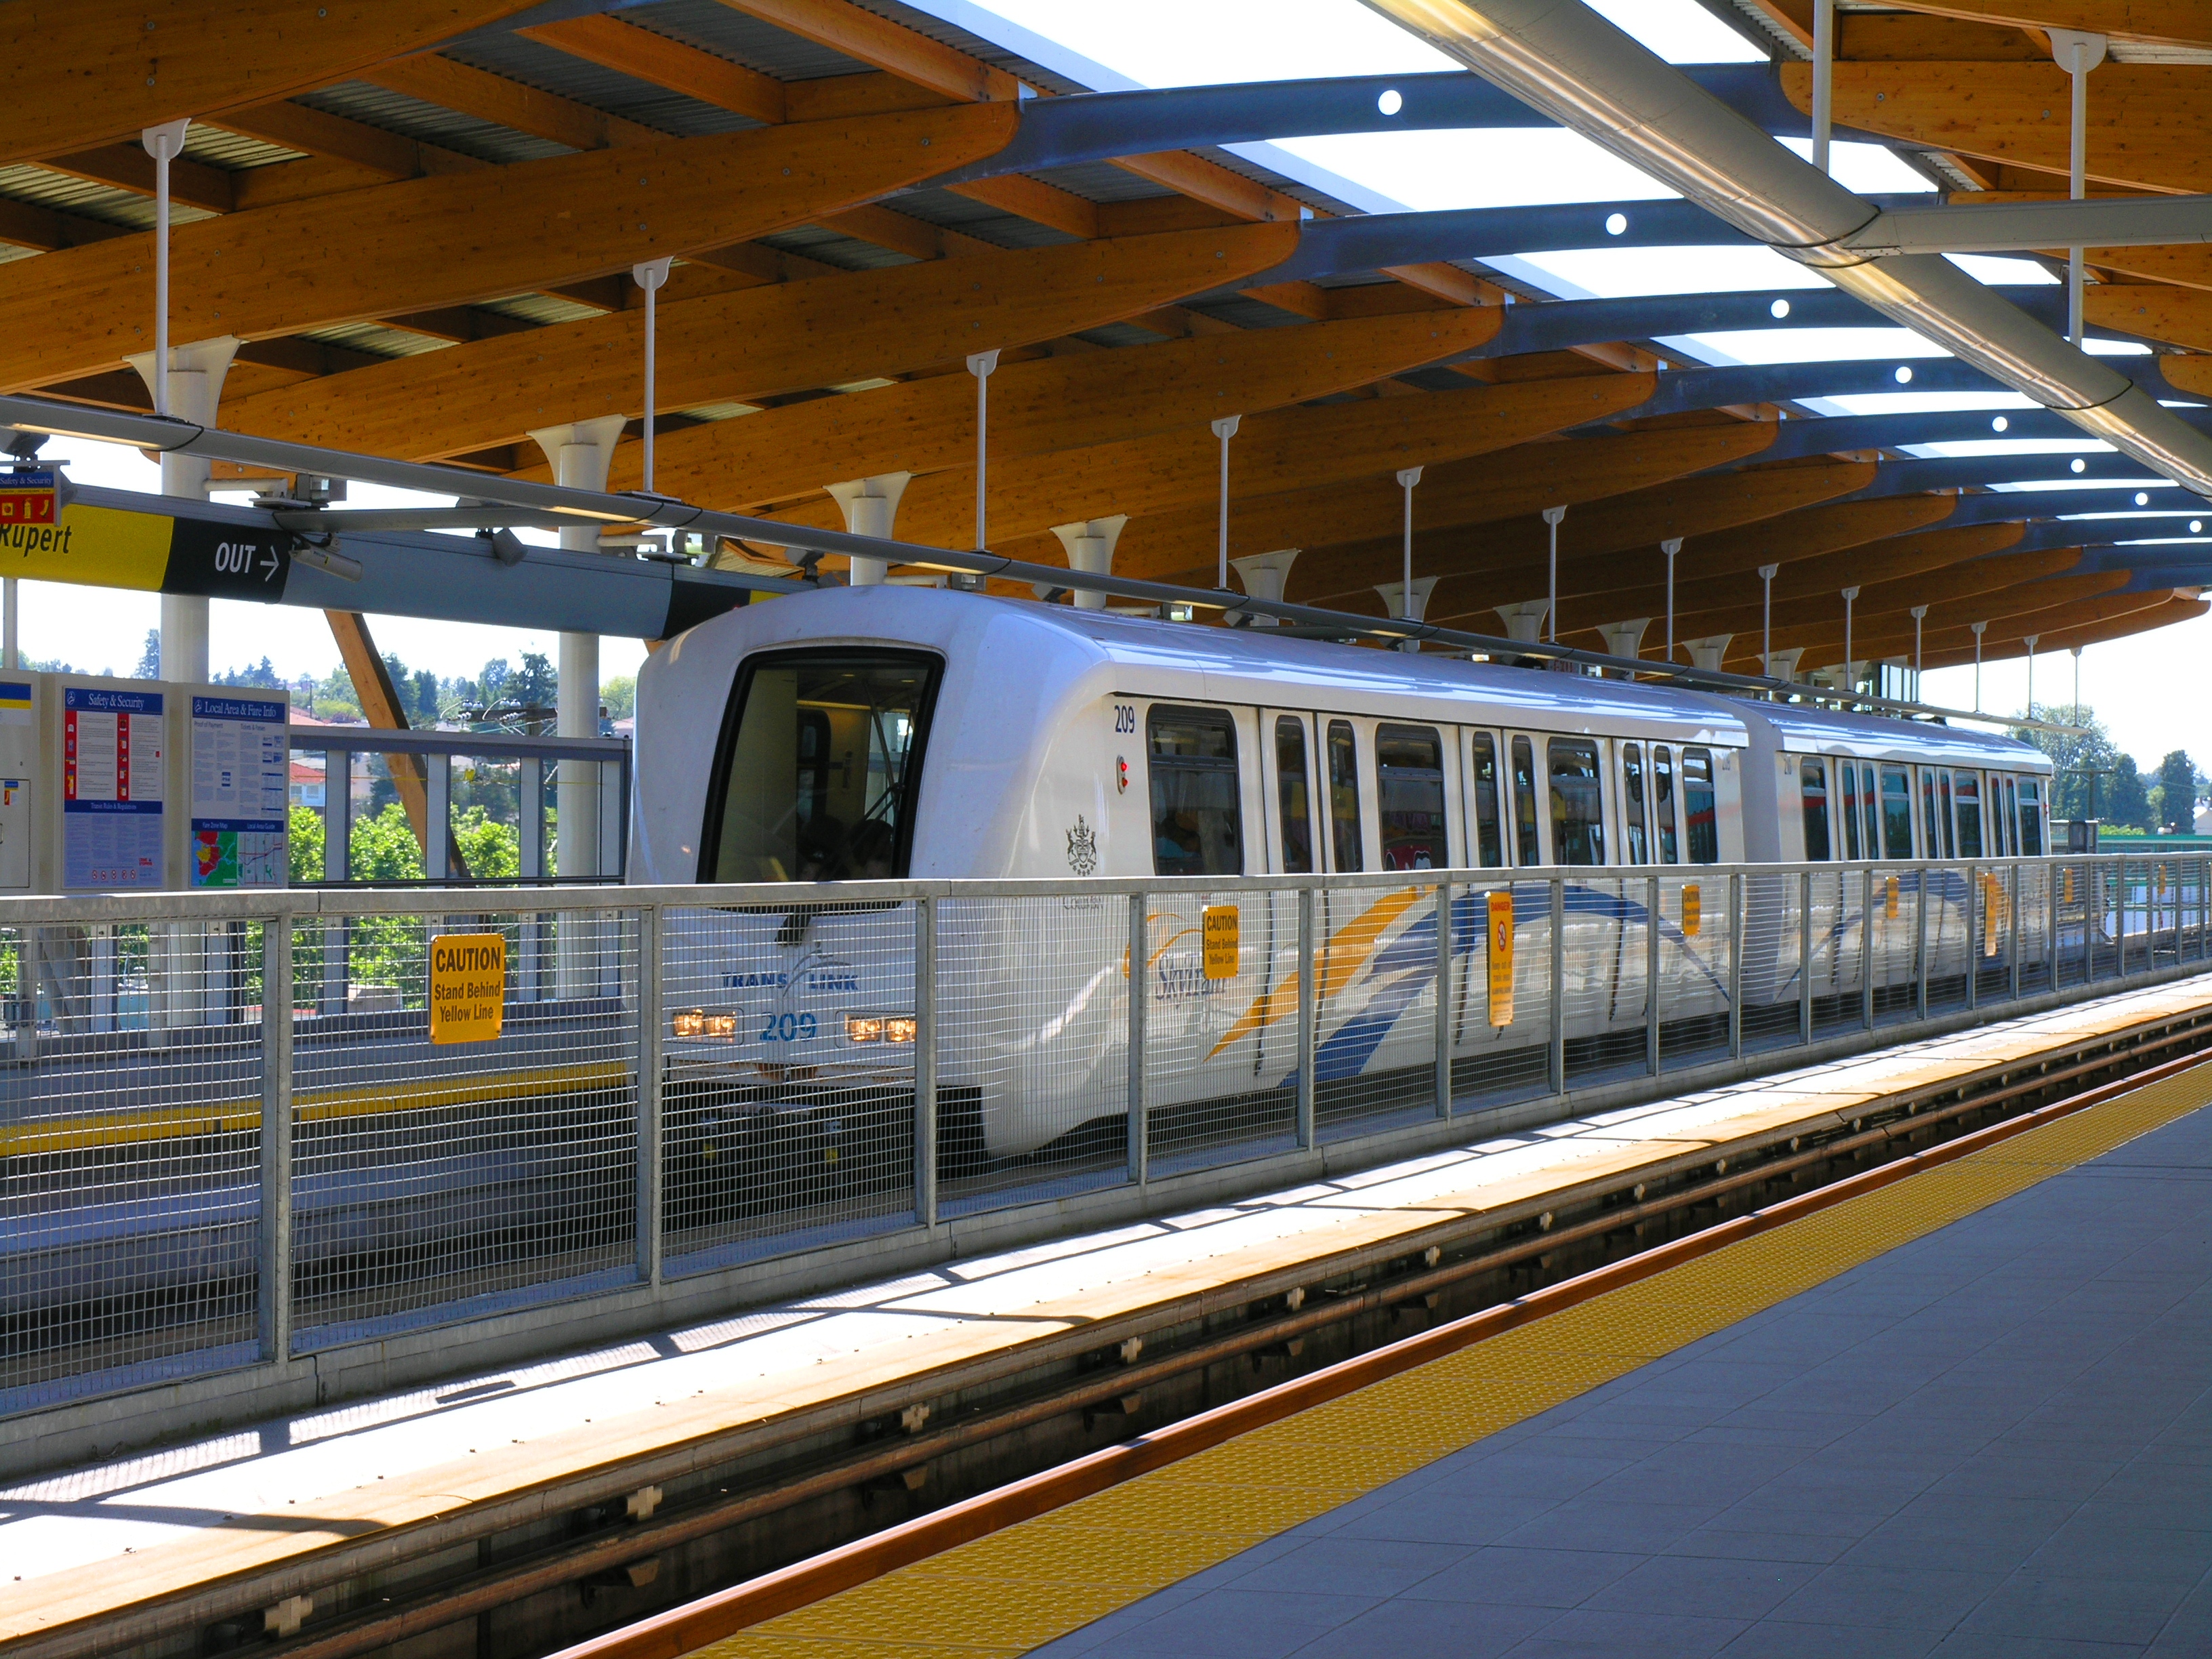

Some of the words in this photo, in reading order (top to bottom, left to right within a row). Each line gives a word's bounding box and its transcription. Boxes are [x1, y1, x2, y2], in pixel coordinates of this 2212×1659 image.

[0, 477, 18, 485] Safety
[27, 476, 52, 485] Security
[215, 542, 256, 573] OUT
[89, 693, 108, 708] Safety
[110, 695, 117, 706] &
[117, 695, 144, 711] Security
[205, 701, 223, 714] Local
[224, 703, 239, 715] Area
[240, 703, 247, 716] &
[247, 704, 262, 716] Fare
[263, 705, 276, 717] Info
[1114, 705, 1134, 734] 209
[1490, 901, 1511, 912] DANGER
[1207, 915, 1239, 932] CAUTION
[1206, 939, 1221, 950] Stand
[1222, 938, 1239, 950] Behind
[436, 947, 501, 972] CAUTION
[1208, 953, 1225, 965] Yellow
[721, 972, 788, 989] TRANS
[809, 974, 859, 991] LINK
[434, 983, 464, 1001] Stand
[468, 981, 501, 999] Behind
[440, 1005, 472, 1023] Yellow
[474, 1004, 494, 1021] Line
[760, 1011, 817, 1042] 209
